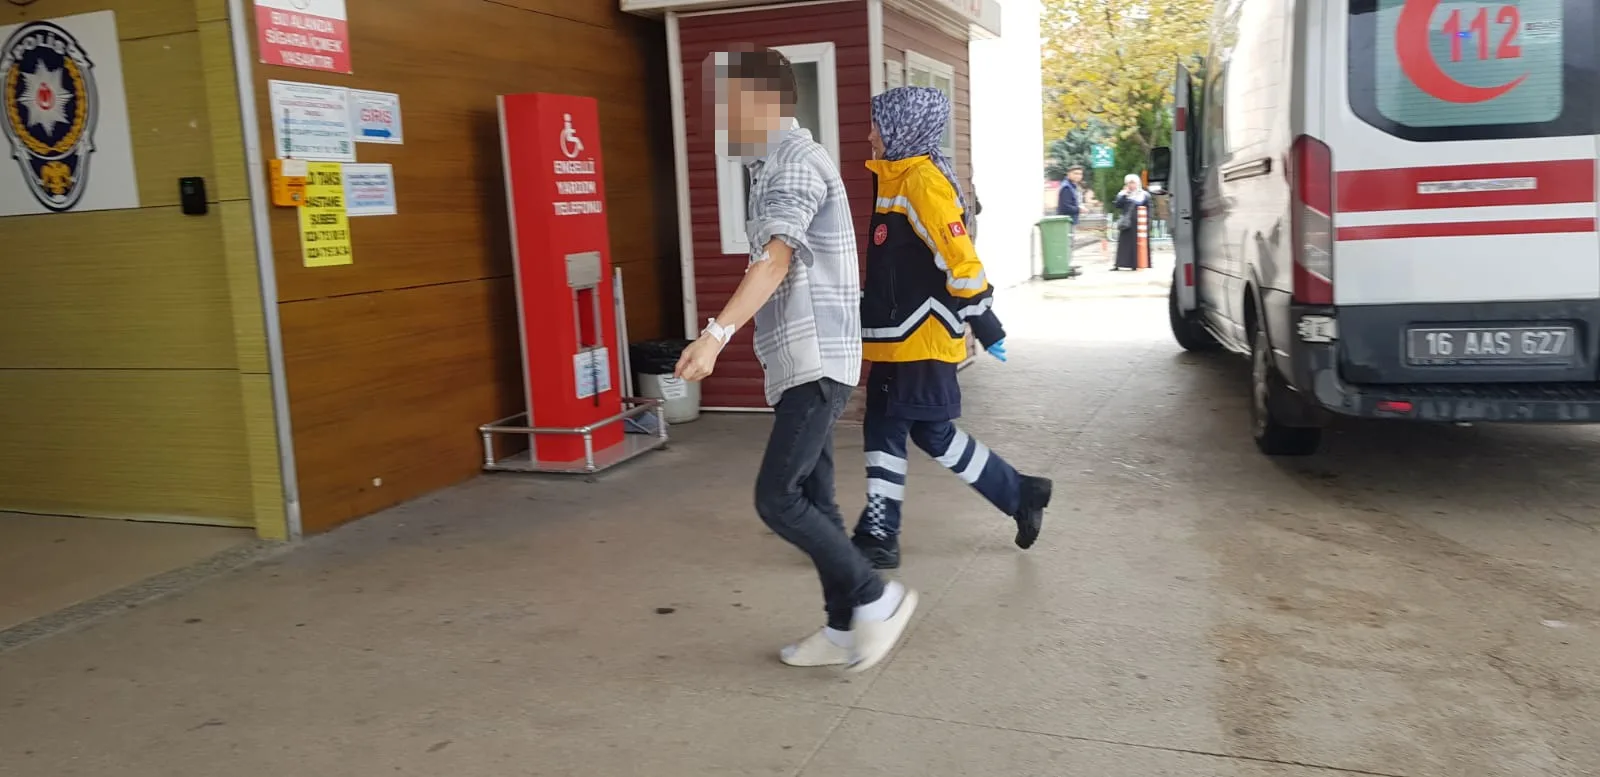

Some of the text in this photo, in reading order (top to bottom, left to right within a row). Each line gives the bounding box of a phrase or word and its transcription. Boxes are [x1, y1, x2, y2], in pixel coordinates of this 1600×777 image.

[270, 10, 335, 34] BU ALANDA
[1441, 5, 1523, 63] 112
[553, 157, 595, 174] ENGELLİ
[555, 181, 597, 195] YARDIM
[552, 200, 602, 216] TELEFONU
[1425, 331, 1567, 355] 16 AAS 627
